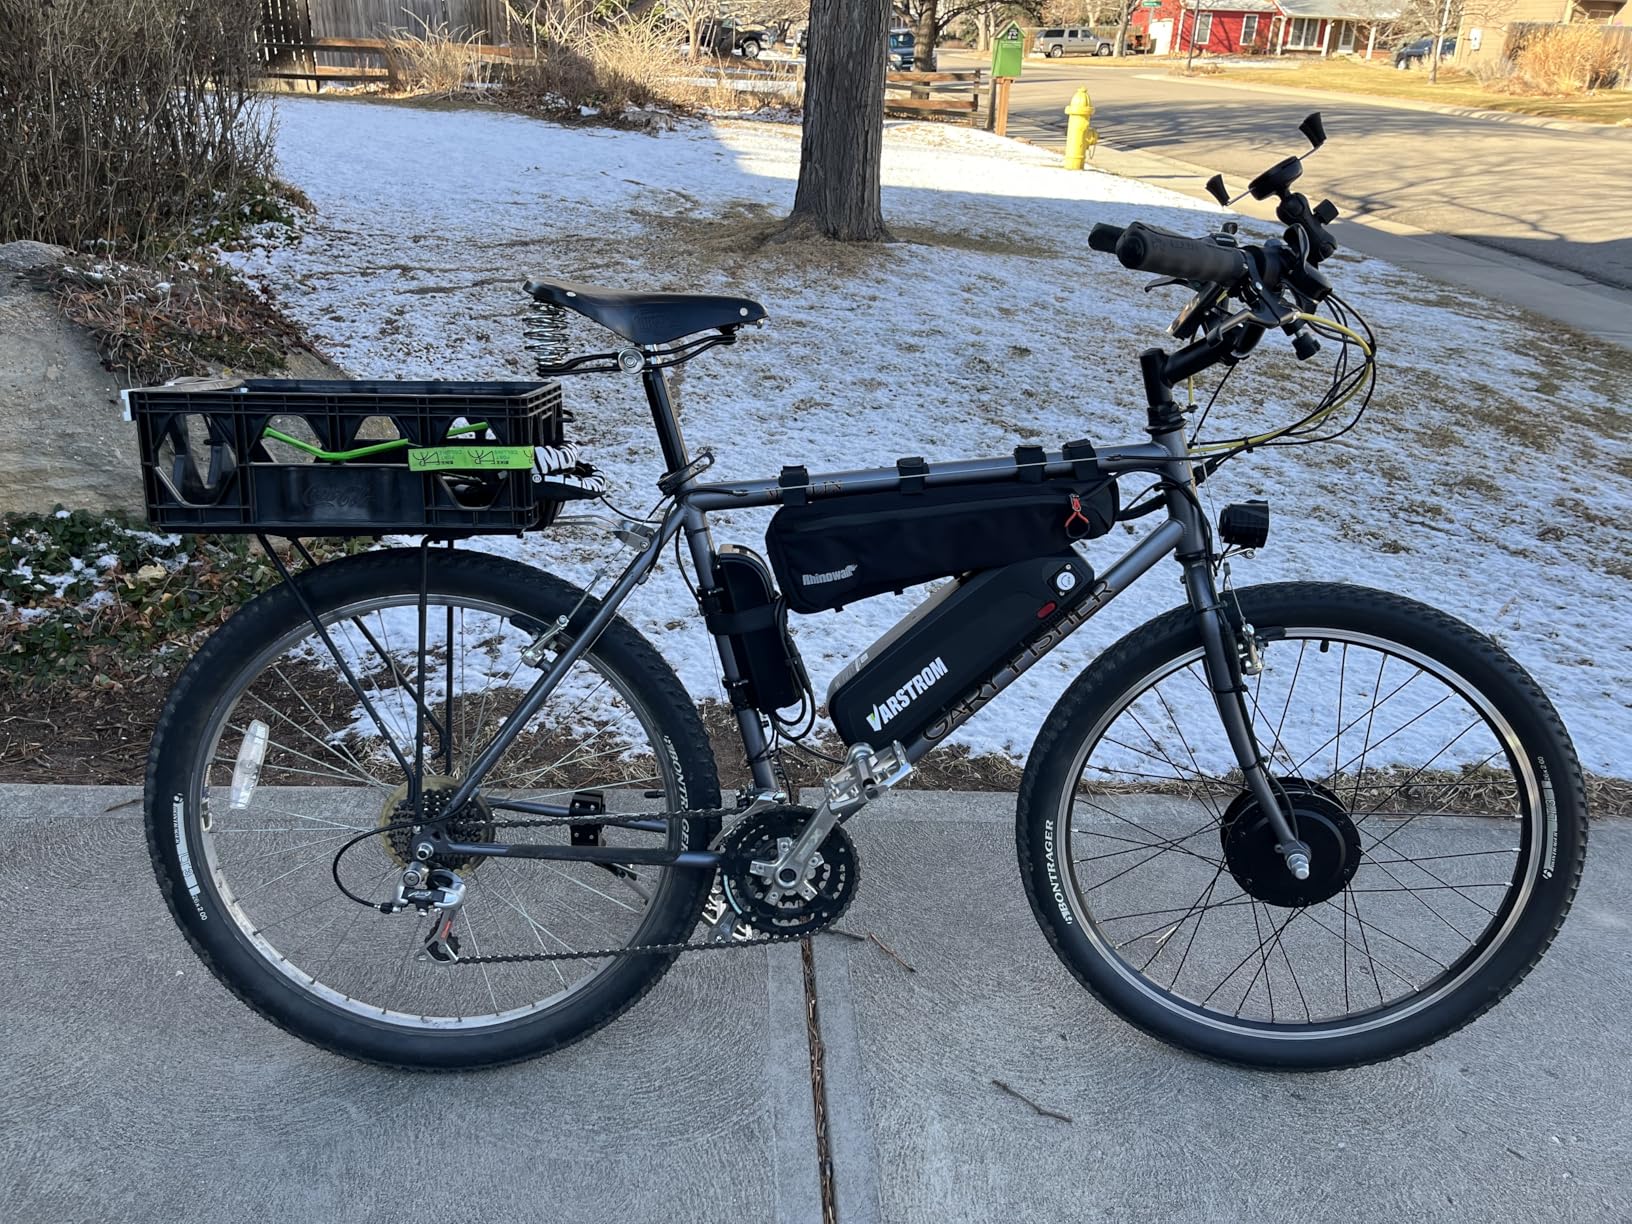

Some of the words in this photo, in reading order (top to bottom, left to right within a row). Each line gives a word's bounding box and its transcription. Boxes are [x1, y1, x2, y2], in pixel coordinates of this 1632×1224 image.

[866, 656, 949, 732] VARSTROM
[922, 671, 999, 742] GARY
[1007, 579, 1113, 675] FISHER
[668, 749, 690, 851] BONTRGER
[1044, 819, 1072, 914] BONTRAGER
